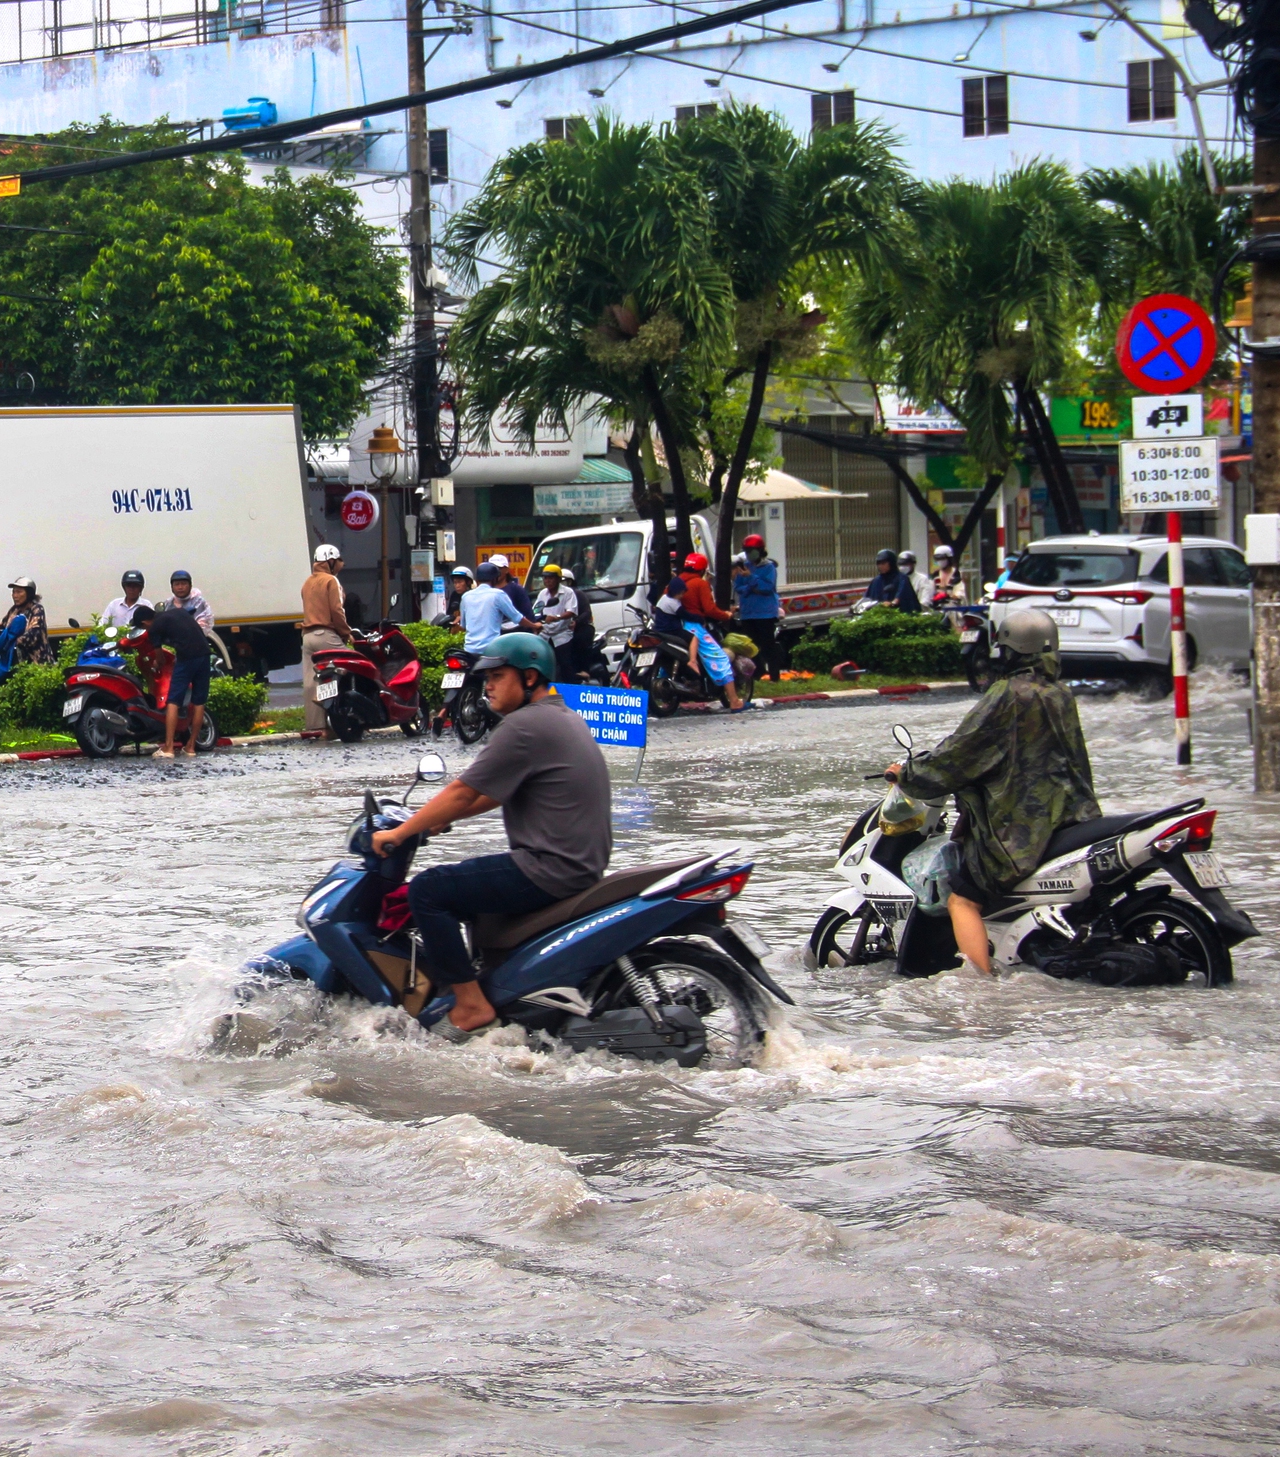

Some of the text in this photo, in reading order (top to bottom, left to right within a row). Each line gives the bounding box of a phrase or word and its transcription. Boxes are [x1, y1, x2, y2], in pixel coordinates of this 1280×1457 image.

[1131, 467, 1210, 482] 10:30-12:00
[112, 488, 193, 514] 94C-074.31
[580, 690, 642, 708] CÔNG TRƯỜNG
[602, 711, 616, 723] THI
[618, 711, 643, 725] CÔNG
[601, 727, 628, 742] CHẬM
[1096, 854, 1119, 871] LX
[1037, 880, 1075, 890] YAMAHA
